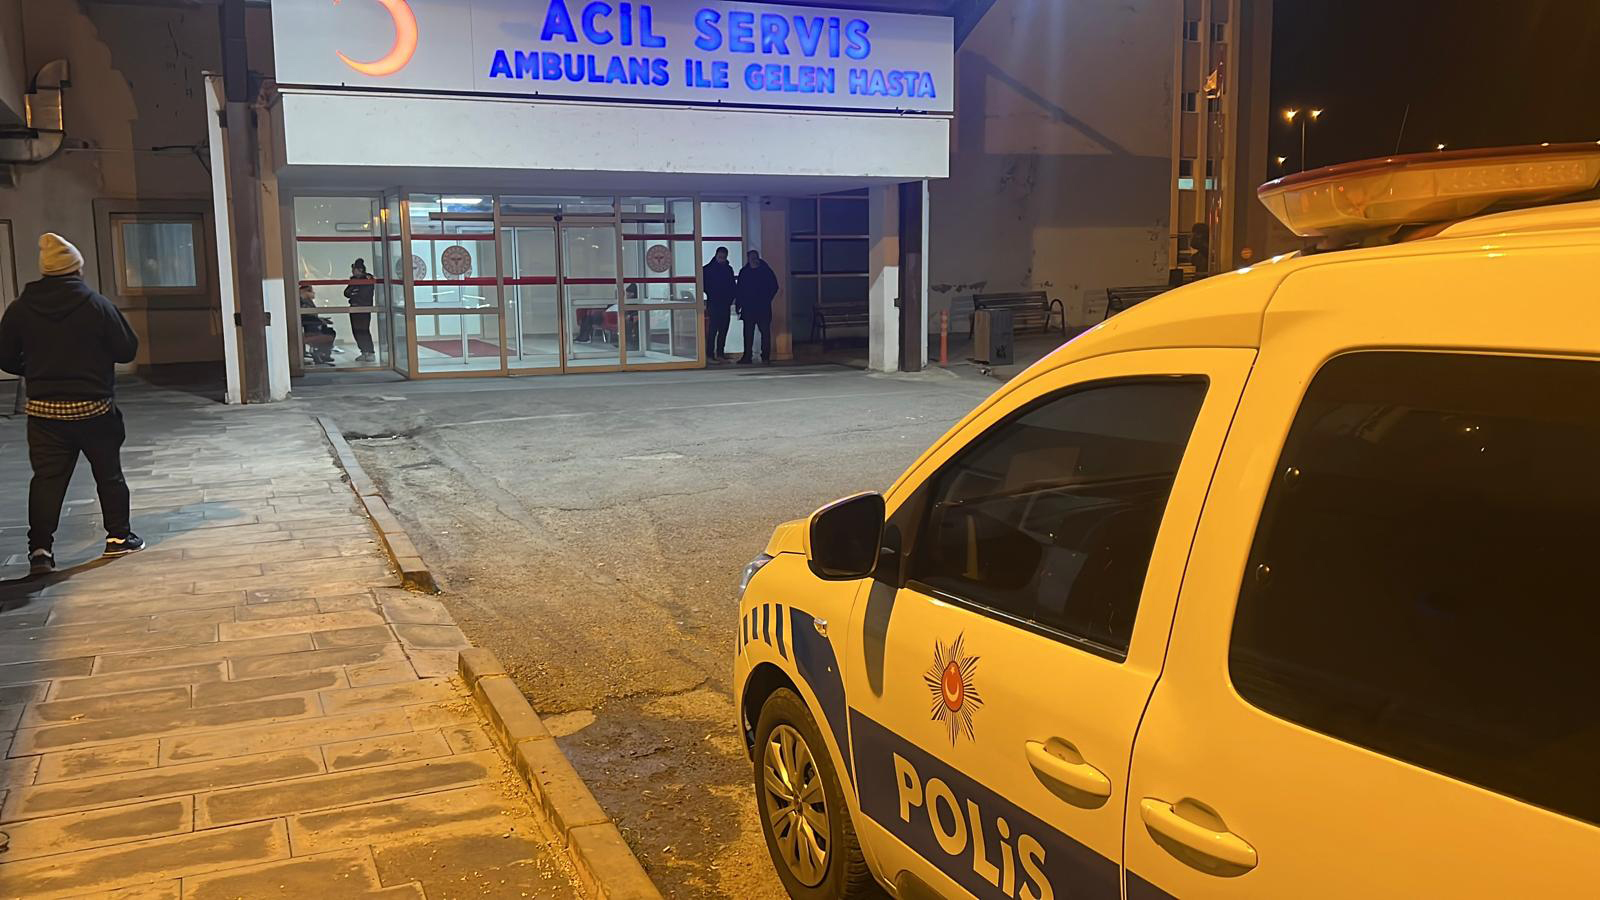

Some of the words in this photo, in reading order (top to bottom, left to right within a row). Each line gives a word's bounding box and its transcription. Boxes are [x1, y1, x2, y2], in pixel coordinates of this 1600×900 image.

[489, 50, 670, 86] AMBULANS
[744, 63, 835, 93] GELEN
[849, 68, 937, 98] HASTA
